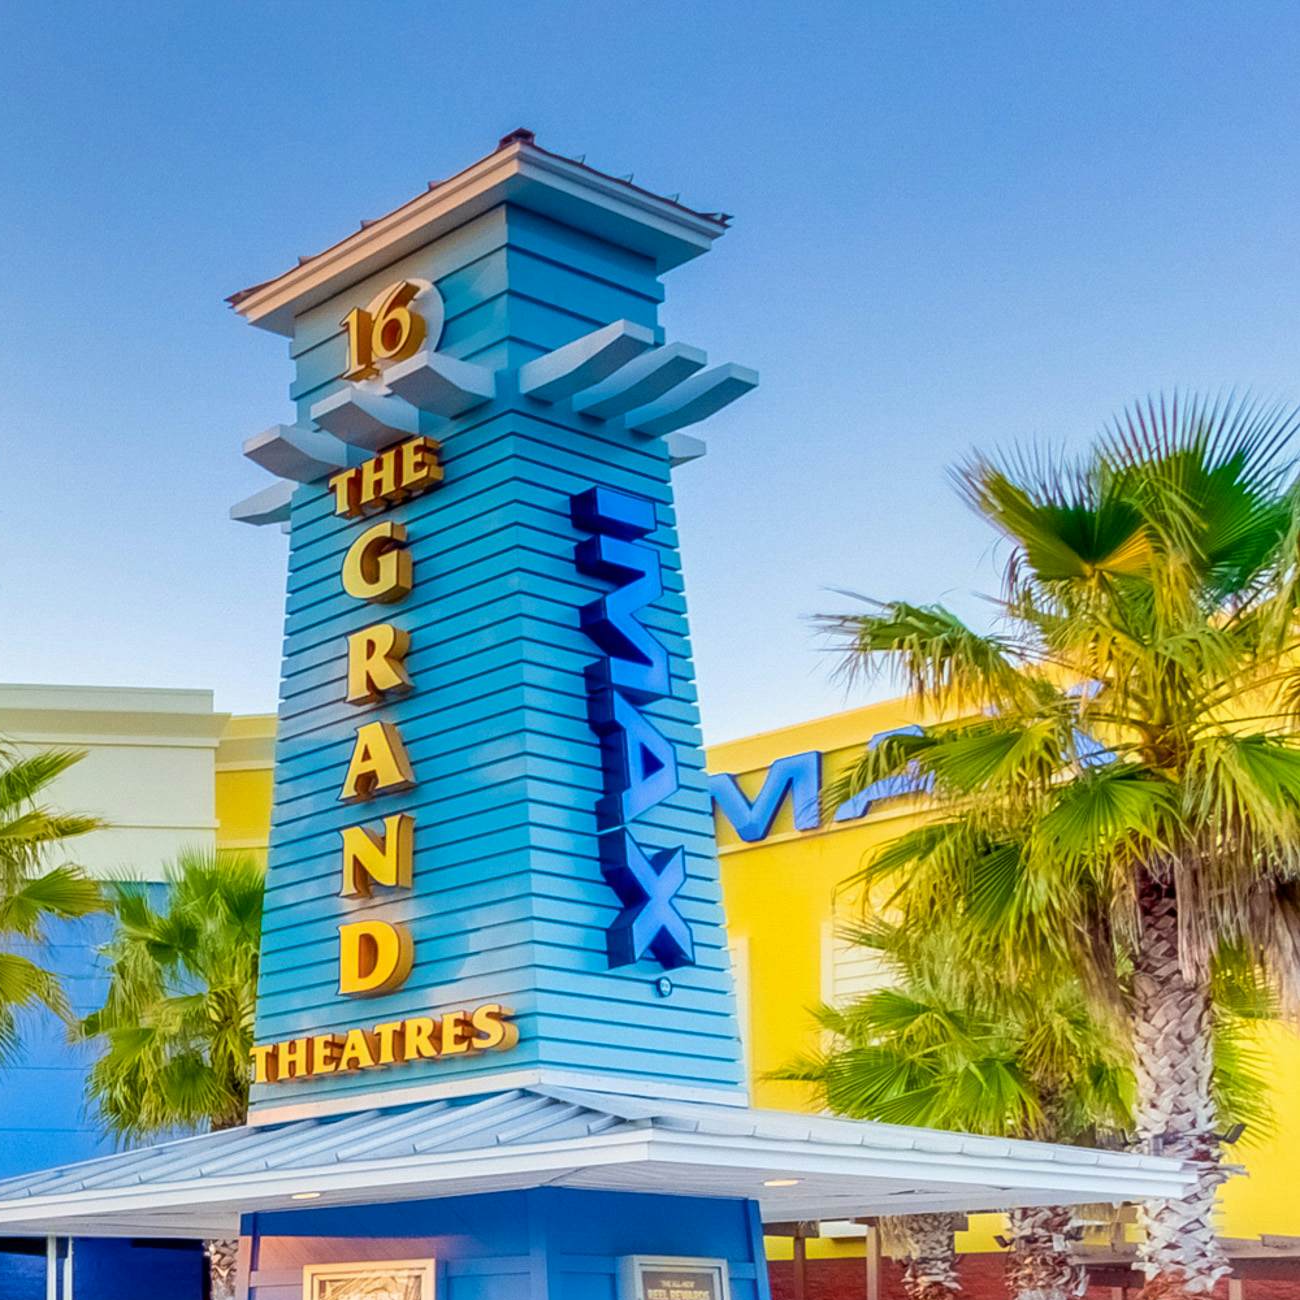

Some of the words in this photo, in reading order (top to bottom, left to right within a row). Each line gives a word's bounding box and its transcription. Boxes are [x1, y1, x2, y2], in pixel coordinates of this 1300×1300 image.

[339, 279, 427, 382] 16
[328, 435, 444, 519] THE
[337, 520, 416, 999] GRAND
[570, 484, 697, 970] IMAX
[250, 1003, 520, 1084] THEATRES
